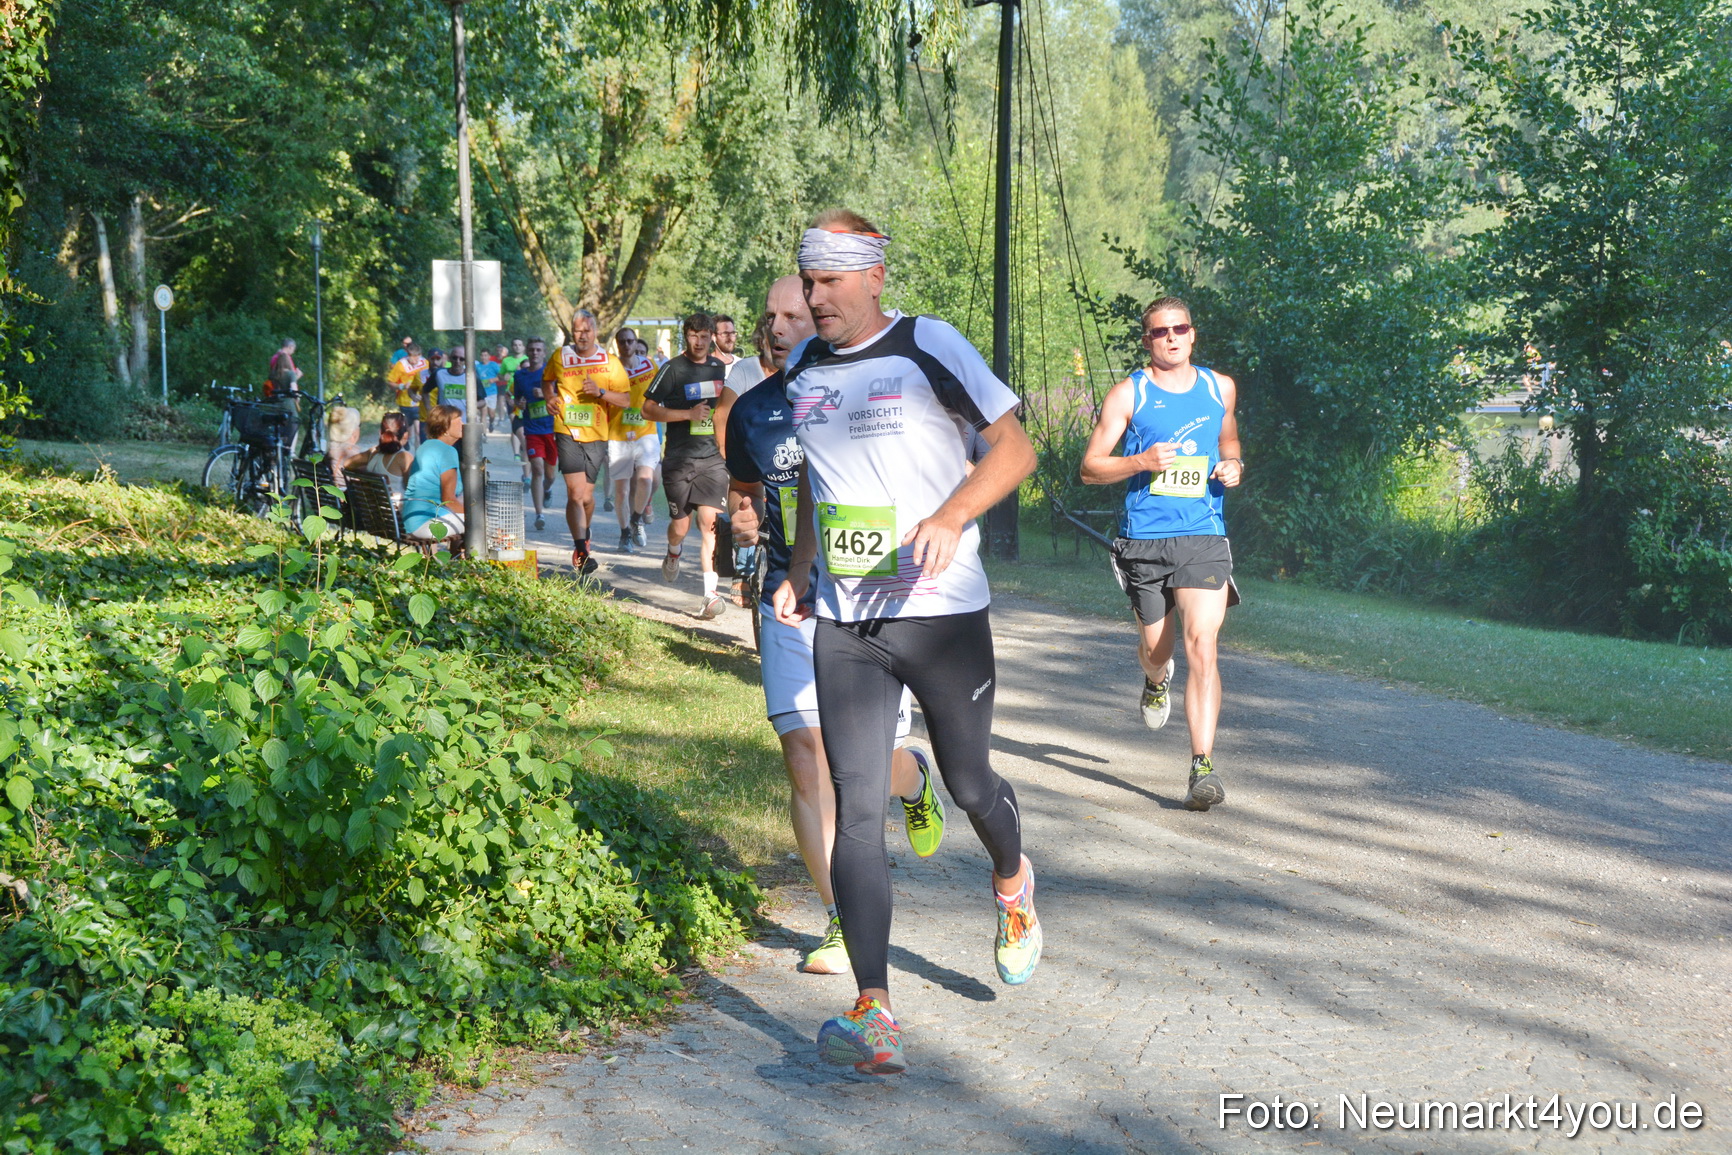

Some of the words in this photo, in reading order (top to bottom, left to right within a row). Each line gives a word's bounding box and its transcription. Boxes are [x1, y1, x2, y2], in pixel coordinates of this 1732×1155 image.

[563, 369, 583, 377] MAX
[587, 366, 610, 375] BÖGL
[567, 411, 590, 421] 1199
[848, 406, 903, 421] VORSICHT!
[849, 420, 904, 434] Freilaufende
[1174, 421, 1195, 437] Schick
[1195, 415, 1210, 424] Bau
[1161, 470, 1201, 486] 1189
[824, 527, 883, 556] 1462
[831, 554, 855, 563] Hampel
